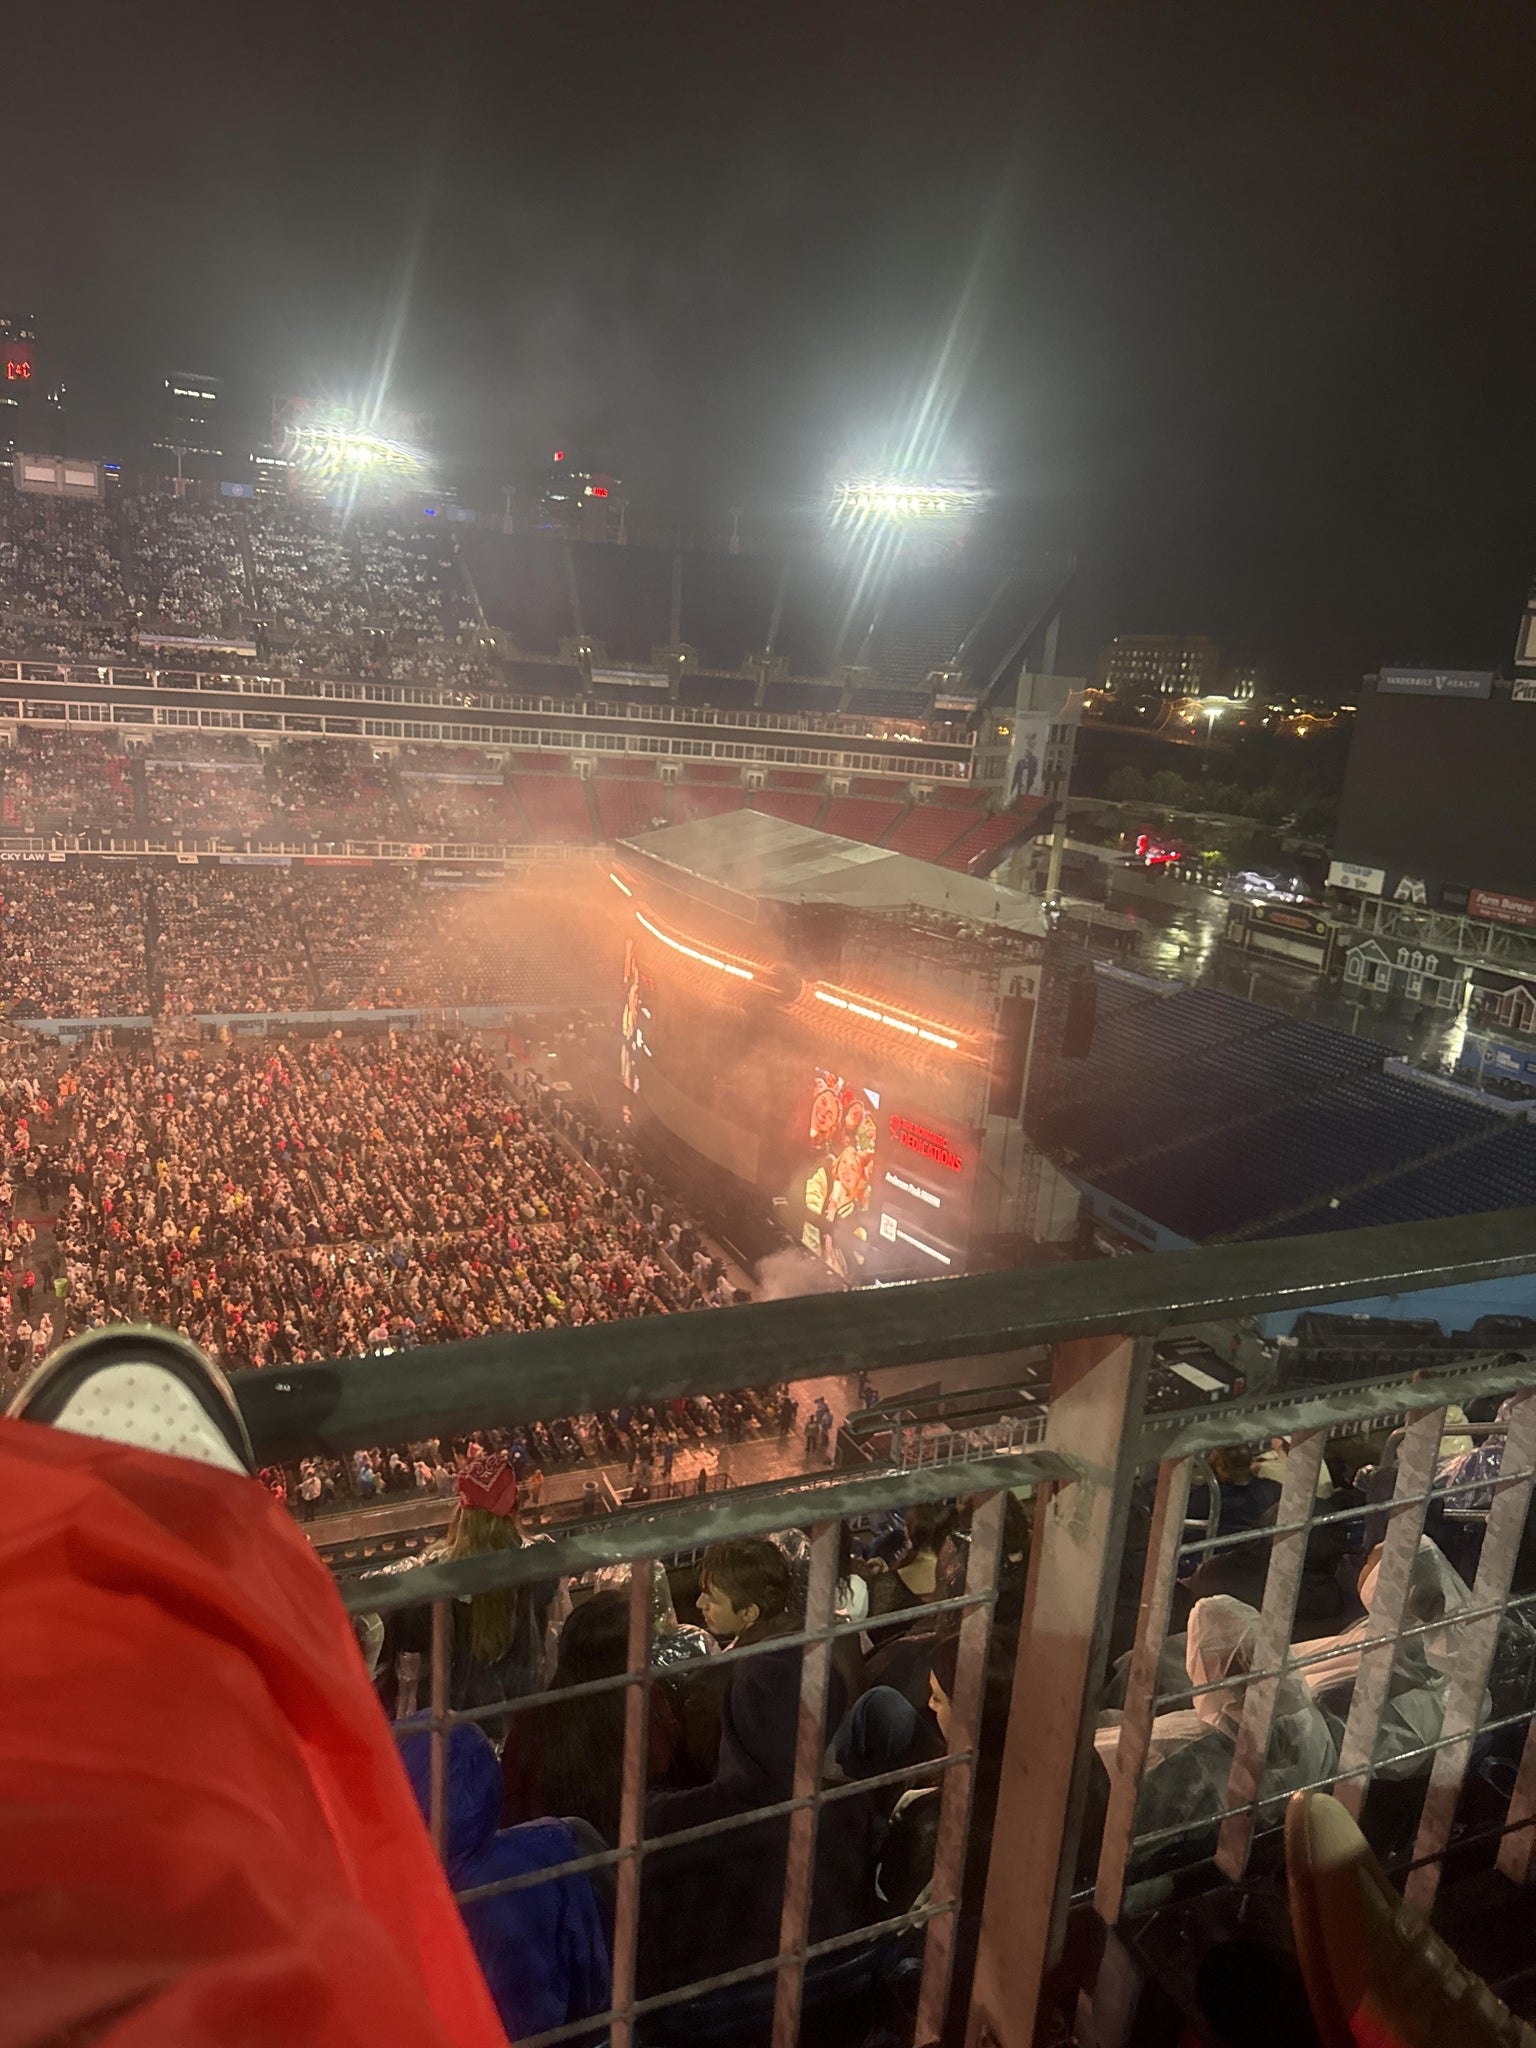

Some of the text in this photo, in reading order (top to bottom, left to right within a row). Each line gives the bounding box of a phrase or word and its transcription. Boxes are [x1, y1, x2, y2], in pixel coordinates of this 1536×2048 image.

[1447, 680, 1481, 689] HEALTH
[23, 853, 45, 861] LAW
[1476, 893, 1534, 914] Farm Bureau
[900, 1131, 962, 1173] DEDICATIONS
